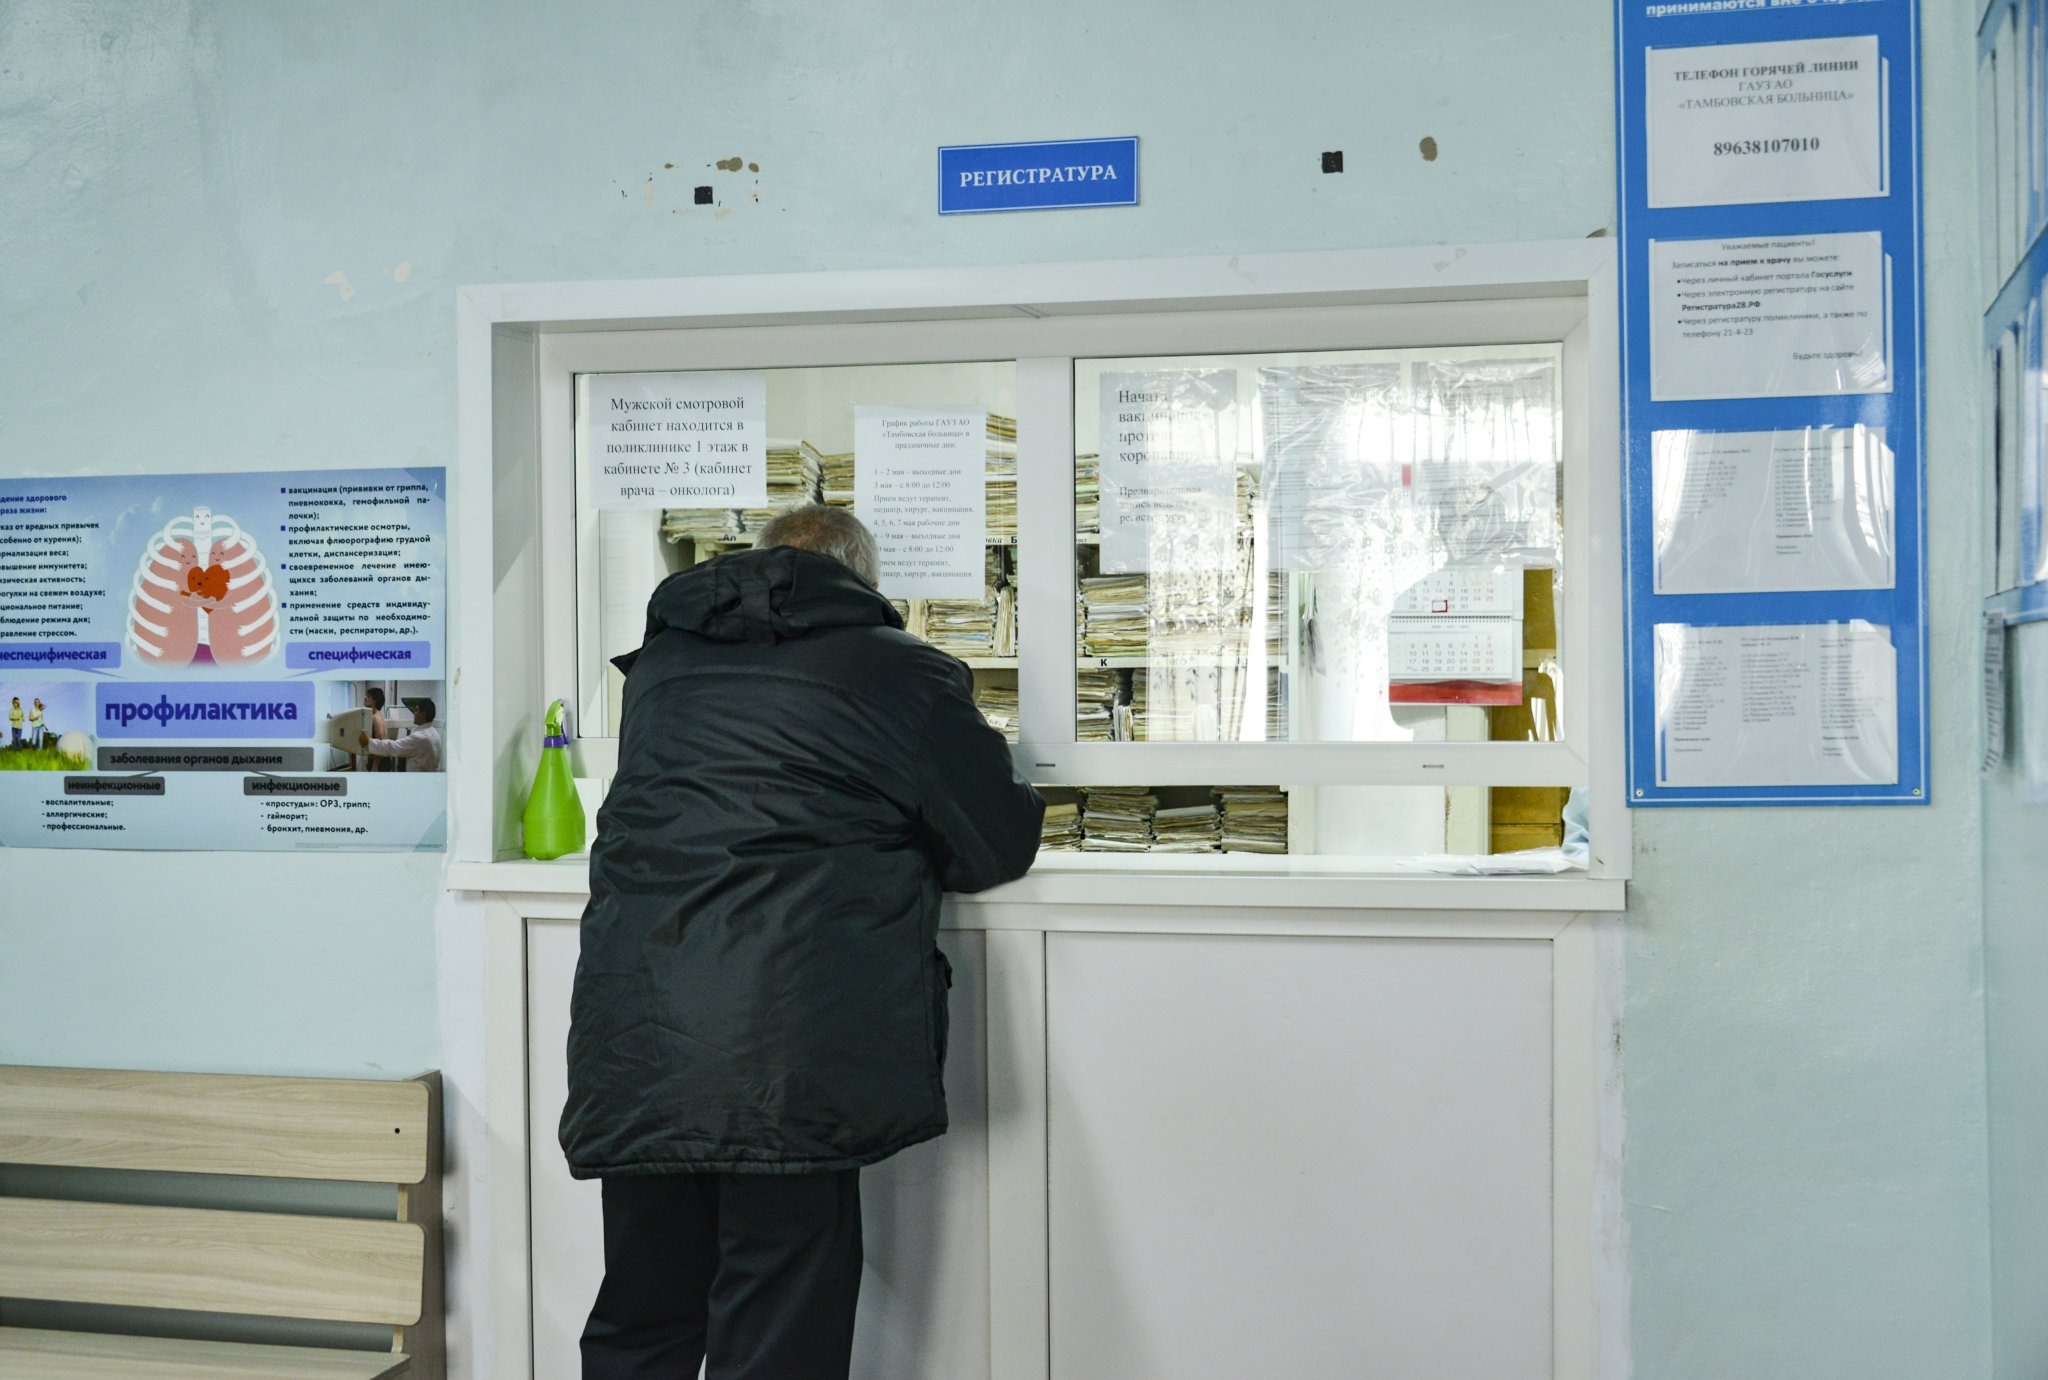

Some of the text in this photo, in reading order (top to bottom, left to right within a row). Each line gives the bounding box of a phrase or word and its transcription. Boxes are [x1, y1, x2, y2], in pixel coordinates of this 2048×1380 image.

[1646, 0, 1766, 16] принимаются
[1674, 60, 1858, 80] ТЕЛЕФОН ГОРЯЧЕЙ ЛИНИИ
[1739, 79, 1792, 92] ГАУЗ АО
[1679, 90, 1854, 110] «ТАМБОВСКАЯ БОЛЬНИЦА»
[1714, 137, 1819, 156] 89638107010
[960, 165, 1117, 187] РЕГИСТРАТУРА
[1730, 258, 1758, 268] прием
[1767, 257, 1790, 266] врачу
[1811, 270, 1852, 280] Госуслуги
[1682, 301, 1760, 312] Регистратура28.РФ
[611, 397, 744, 413] Мужской смотровой
[611, 420, 744, 432] кабинет находится в
[607, 441, 748, 453] поликлинике 1 этаж в
[604, 462, 752, 476] кабинете № 3 (кабинет
[289, 487, 337, 495] вакцинация
[339, 485, 383, 494] (прививки
[397, 484, 428, 494] гриппа,
[621, 484, 735, 499] врача онколога)
[26, 494, 67, 503] здорового
[352, 496, 410, 507] гемофильной
[289, 512, 320, 520] лочки);
[26, 522, 59, 532] вредных
[61, 522, 99, 531] привычек
[289, 524, 410, 533] профилактические осмотры,
[44, 535, 82, 546] курения);
[326, 536, 394, 545] флюорографию
[396, 535, 430, 544] грудной
[0, 550, 47, 559] рмализация
[289, 550, 401, 559] клетки, диспансеризация;
[38, 563, 87, 572] иммунитета;
[289, 563, 354, 572] своевременное
[320, 575, 373, 583] заболеваний
[0, 590, 27, 599] огулки
[70, 589, 105, 598] воздухе;
[48, 603, 83, 611] питание;
[290, 601, 430, 610] применение средств индивиду-
[41, 617, 71, 626] режима
[73, 617, 90, 625] дня;
[290, 614, 319, 622] альной
[376, 613, 430, 621] необходимо-
[39, 630, 77, 639] стрессом.
[305, 626, 336, 635] (маски,
[340, 626, 398, 636] респираторы,
[399, 626, 418, 636] др.).
[308, 646, 411, 664] специфическая
[105, 695, 297, 727] профилактика
[110, 752, 283, 767] заболевания органов дыхания
[68, 778, 161, 794] неинфекционные
[252, 778, 340, 794] инфекционные
[45, 799, 114, 808] воспалительные;
[266, 799, 371, 810] «простуды»: ОРЗ, грипп;
[46, 810, 108, 821] аллергические;
[267, 811, 308, 822] гайморит;
[46, 822, 126, 833] профессиональные.
[267, 824, 368, 835] бронхит, пневмония, др.
